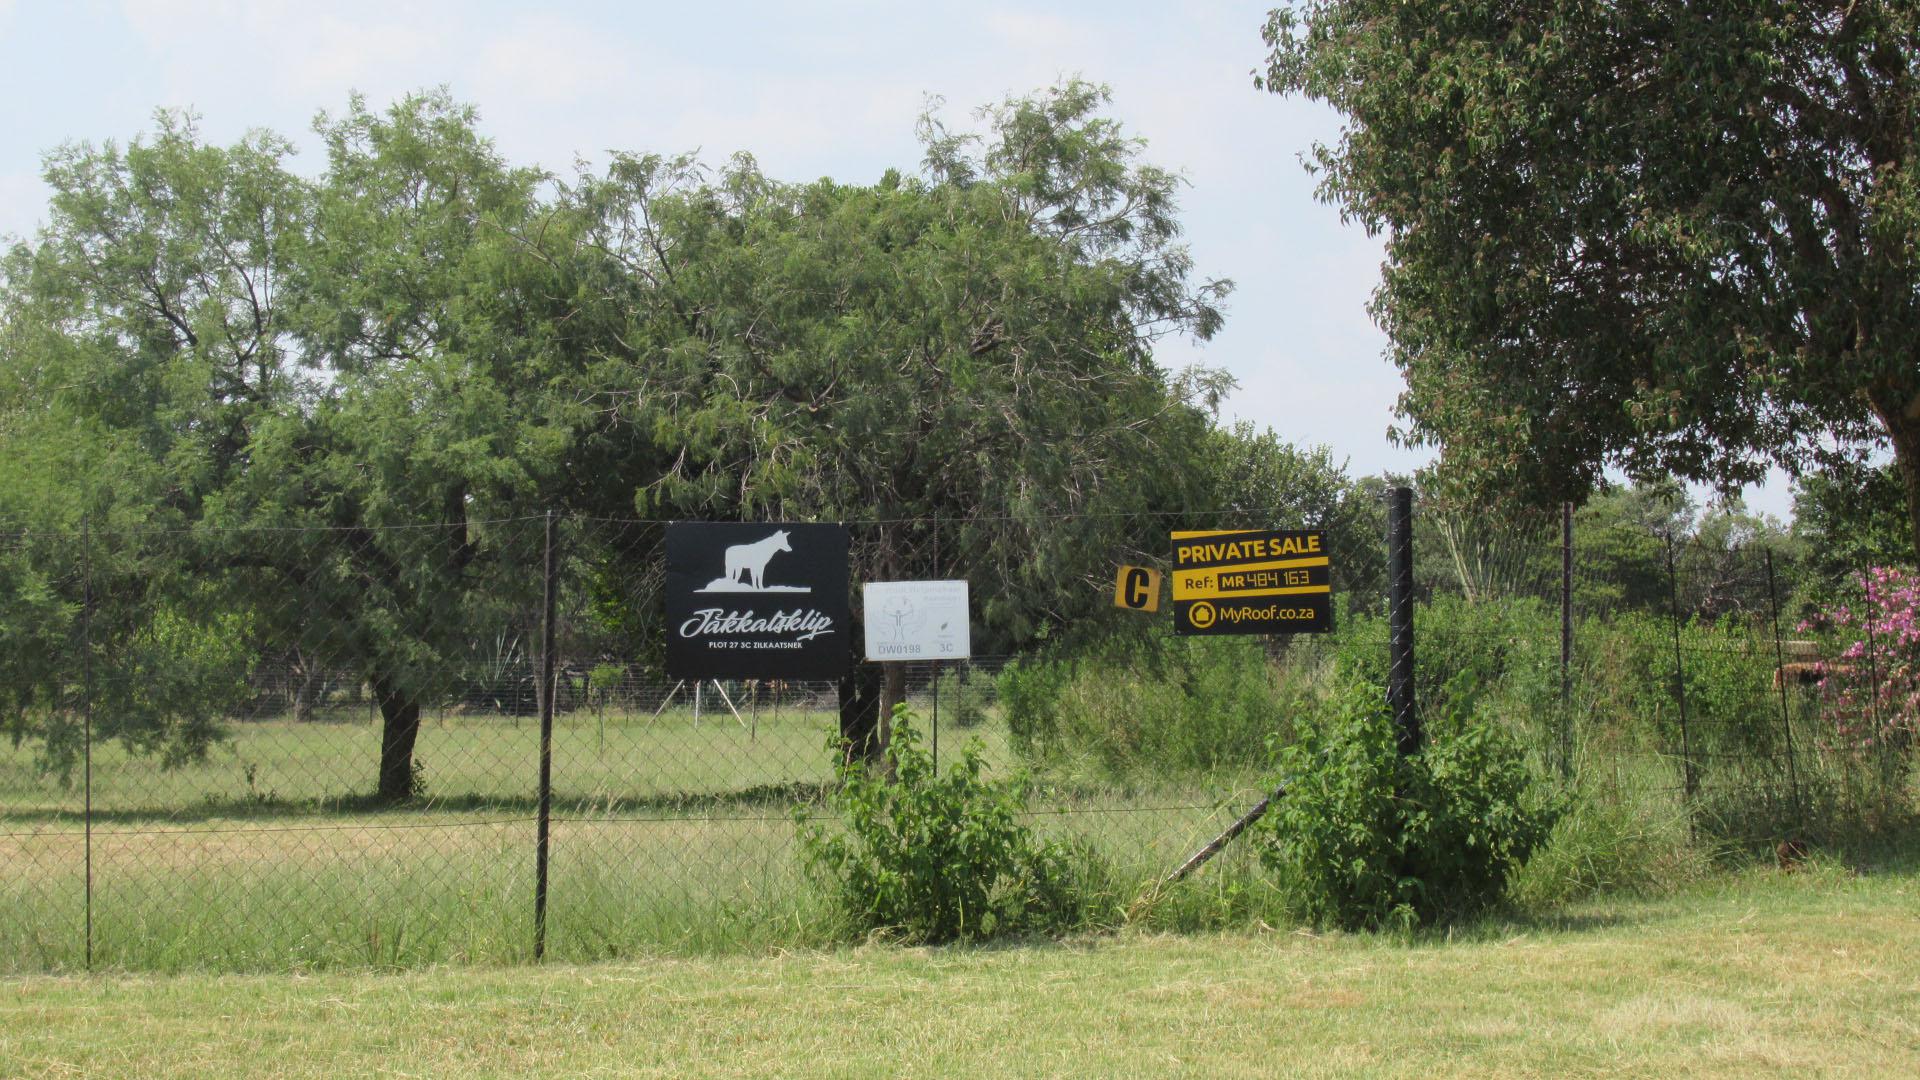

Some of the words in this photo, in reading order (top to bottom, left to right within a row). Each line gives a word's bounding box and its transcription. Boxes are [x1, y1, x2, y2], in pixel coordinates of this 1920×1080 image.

[1178, 539, 1267, 564] PRIVATE
[1269, 535, 1321, 556] SALE
[1124, 568, 1150, 609] C
[1185, 577, 1214, 590] Ref:
[1221, 576, 1245, 588] MR
[1246, 572, 1278, 587] 484
[1283, 570, 1310, 585] 163
[1220, 605, 1315, 623] MyRoof.co.za
[679, 608, 835, 641] Jakkalsklip
[708, 641, 727, 649] PLOT
[729, 641, 739, 649] 27
[740, 641, 752, 649] 3C
[753, 641, 803, 649] ZILKAATSNEK
[878, 644, 921, 654] DW0198
